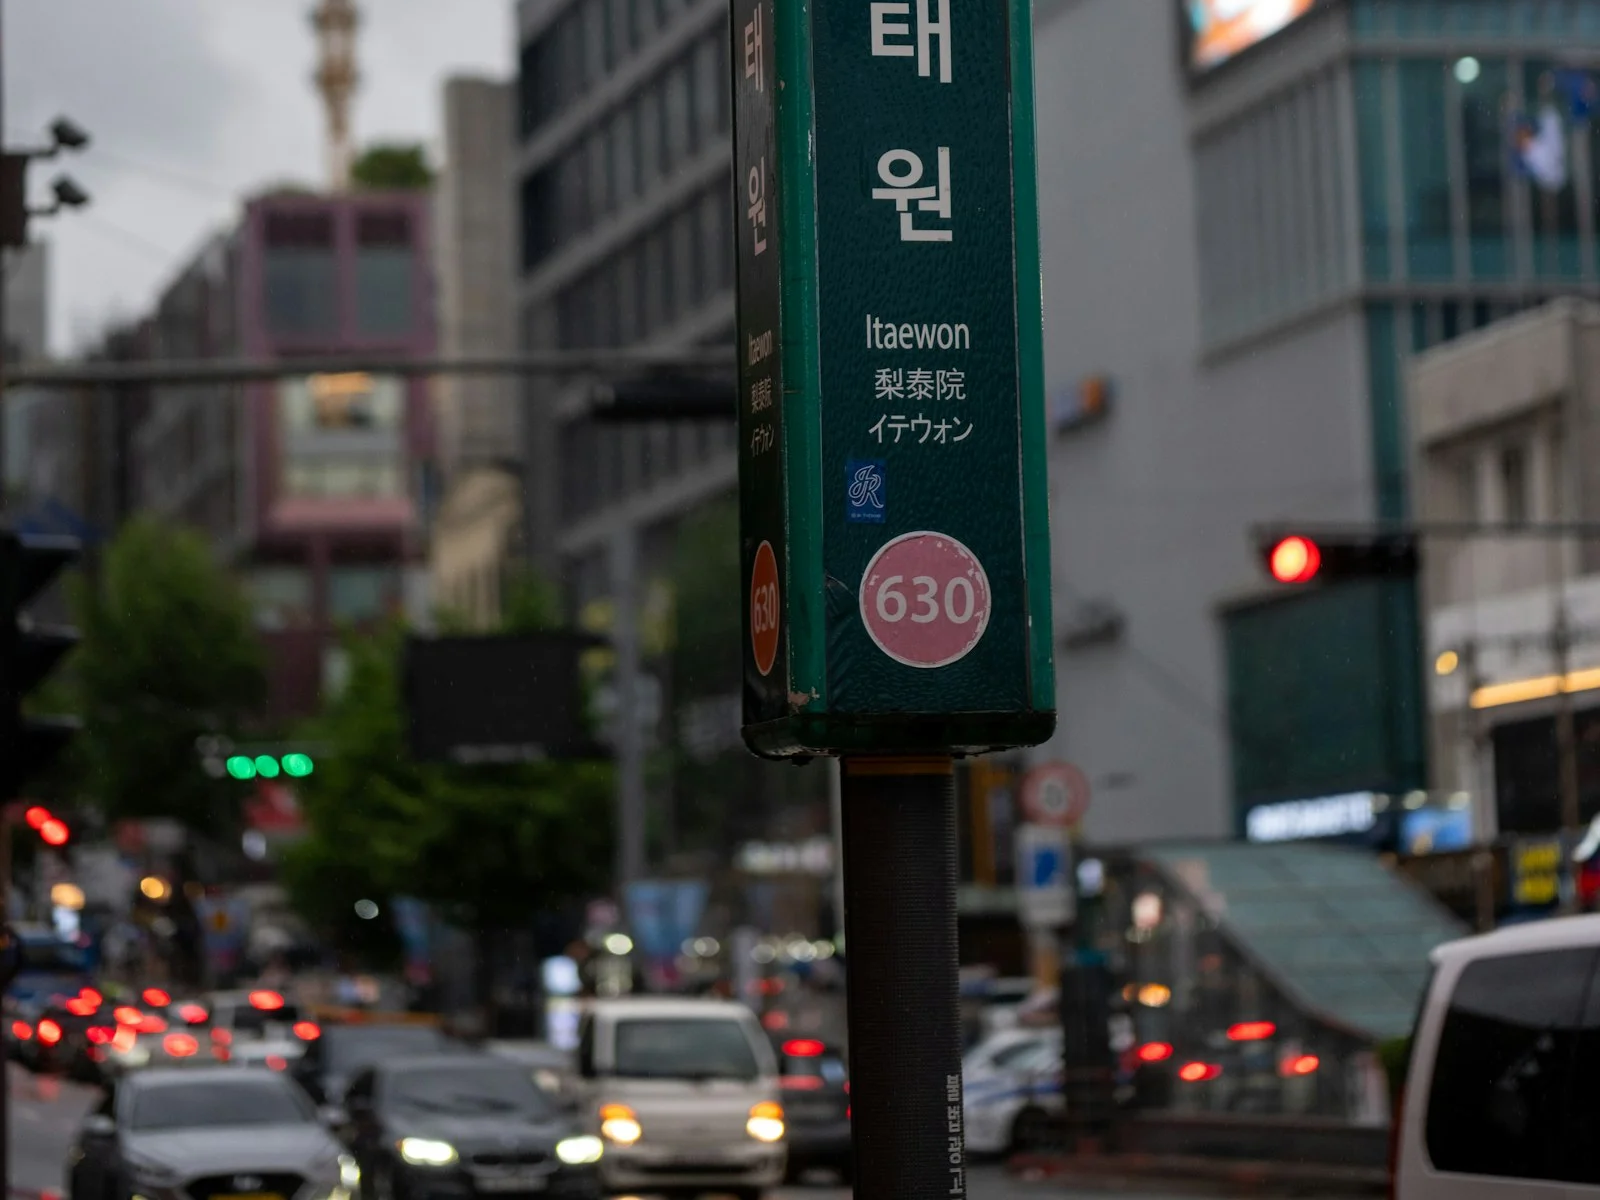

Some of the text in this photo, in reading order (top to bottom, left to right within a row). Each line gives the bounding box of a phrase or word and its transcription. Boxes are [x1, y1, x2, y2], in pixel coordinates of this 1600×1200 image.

[748, 327, 773, 367] Itaewon
[866, 314, 970, 350] Itaewon
[751, 377, 773, 414] 梨泰院
[874, 367, 966, 401] 梨泰院
[750, 422, 775, 457] イテウォン
[868, 412, 974, 445] イテウォン
[753, 580, 776, 635] 630
[875, 575, 974, 625] 630
